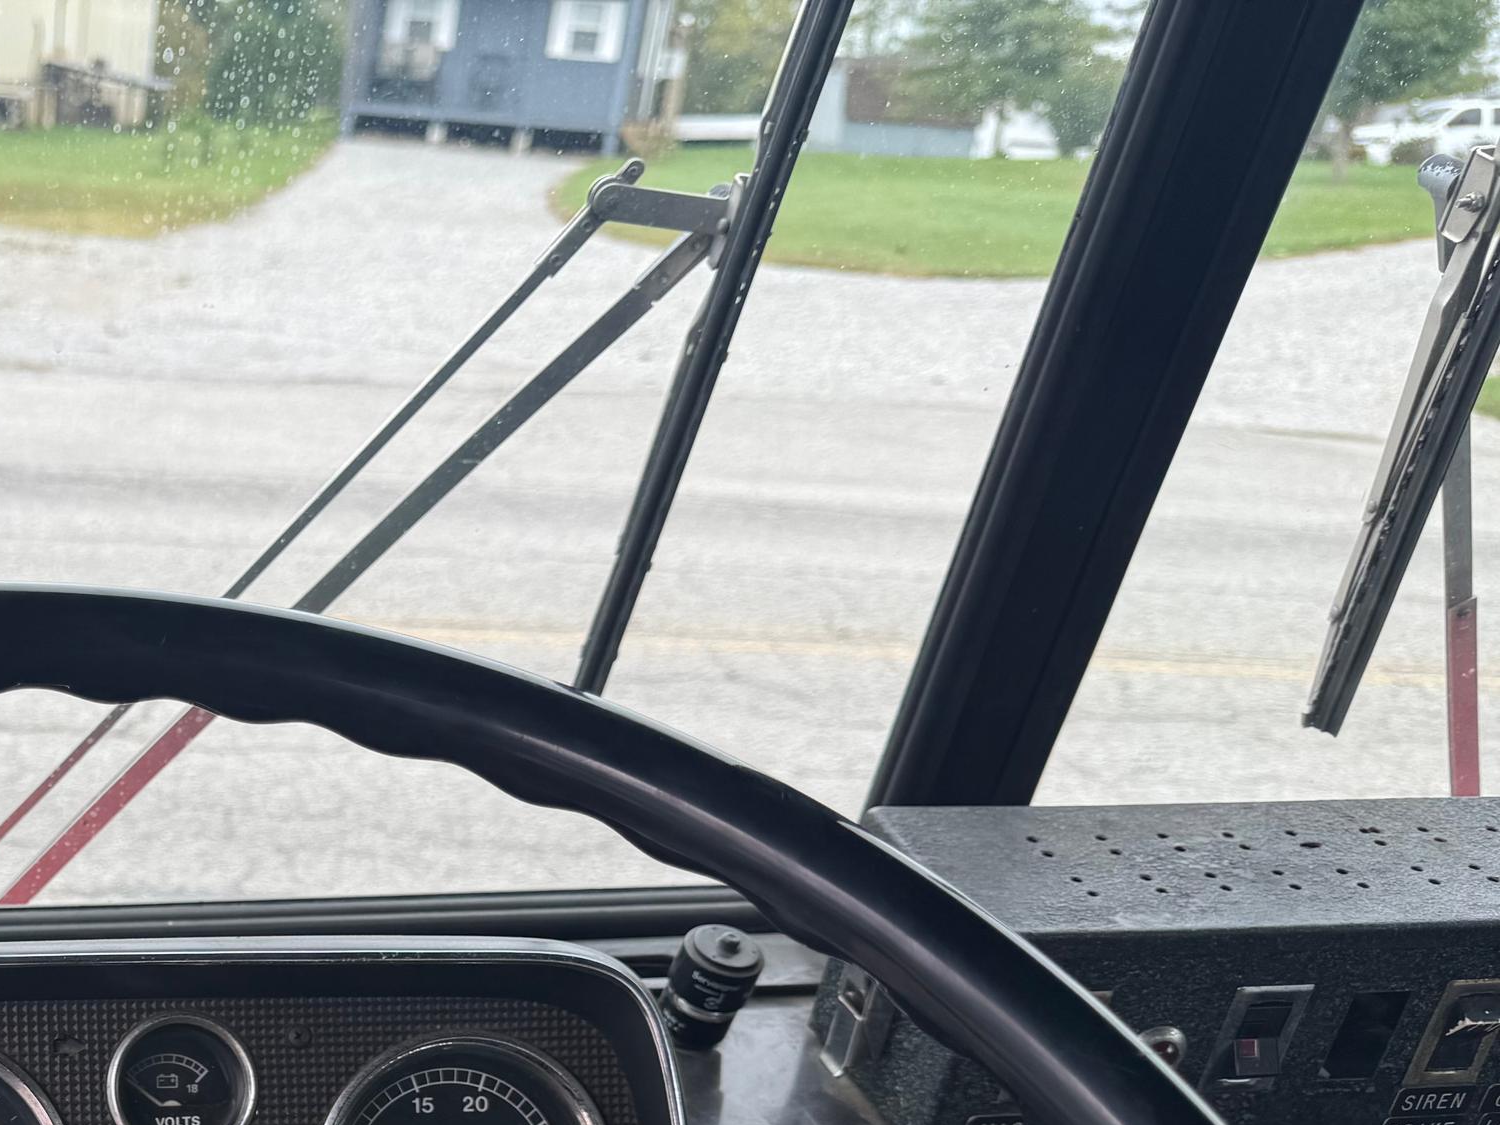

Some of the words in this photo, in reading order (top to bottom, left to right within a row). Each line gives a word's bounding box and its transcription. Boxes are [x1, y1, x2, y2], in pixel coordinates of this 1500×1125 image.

[412, 1097, 435, 1113] 15
[462, 1096, 489, 1113] 20
[1401, 1093, 1467, 1111] SIREN
